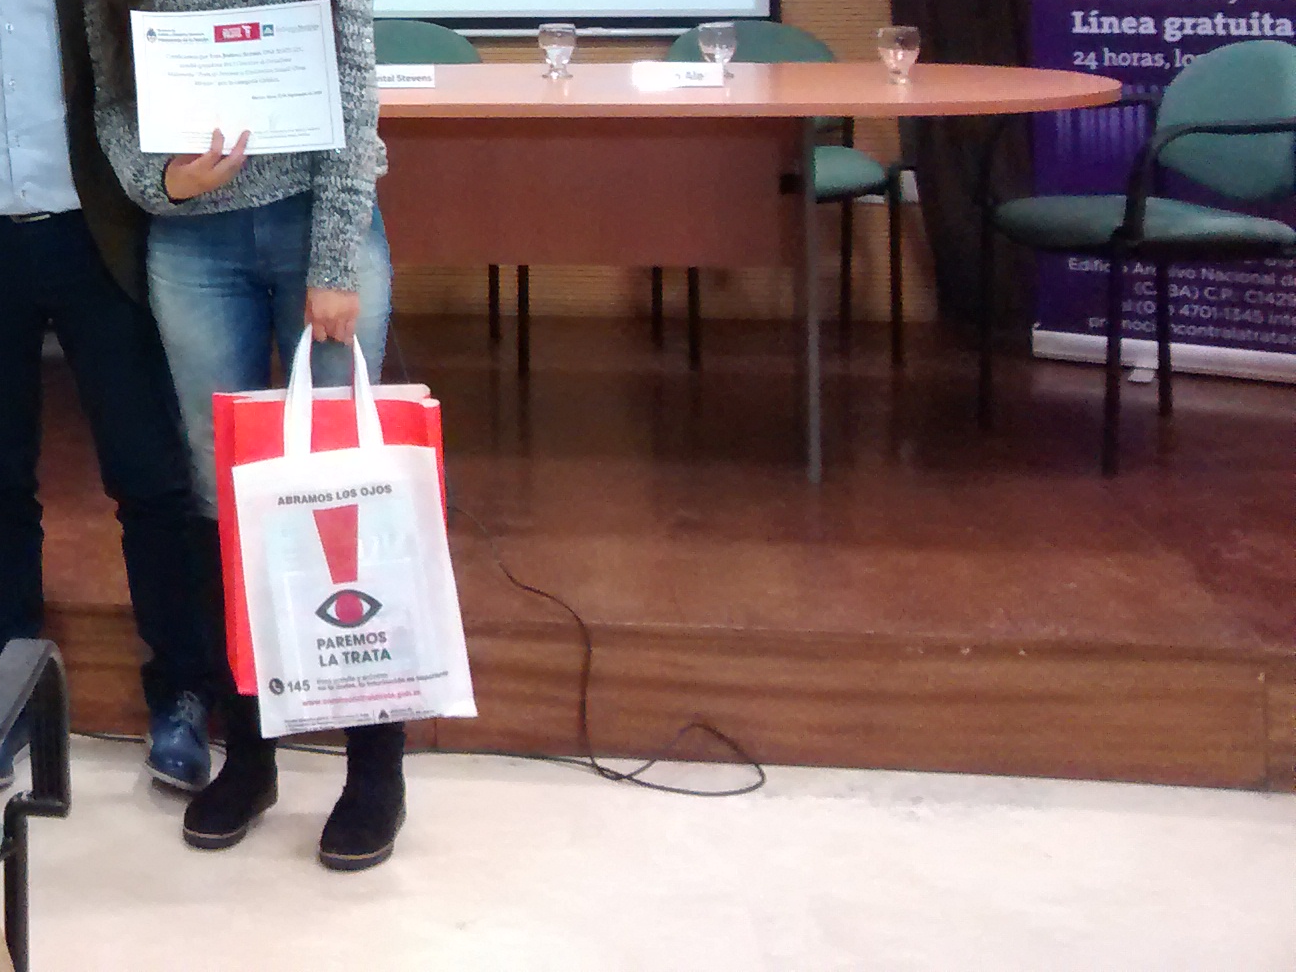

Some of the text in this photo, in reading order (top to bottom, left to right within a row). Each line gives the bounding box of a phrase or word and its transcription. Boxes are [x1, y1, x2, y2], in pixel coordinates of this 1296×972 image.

[1071, 10, 1296, 42] Línea gratuita
[1073, 51, 1098, 70] 24
[1103, 47, 1172, 70] horas,
[396, 74, 433, 83] Stevens
[277, 484, 393, 506] ABRAMOS LOS OJOS
[317, 631, 387, 651] PAREMOS
[319, 648, 393, 668] LA TRATA
[287, 679, 311, 693] 145
